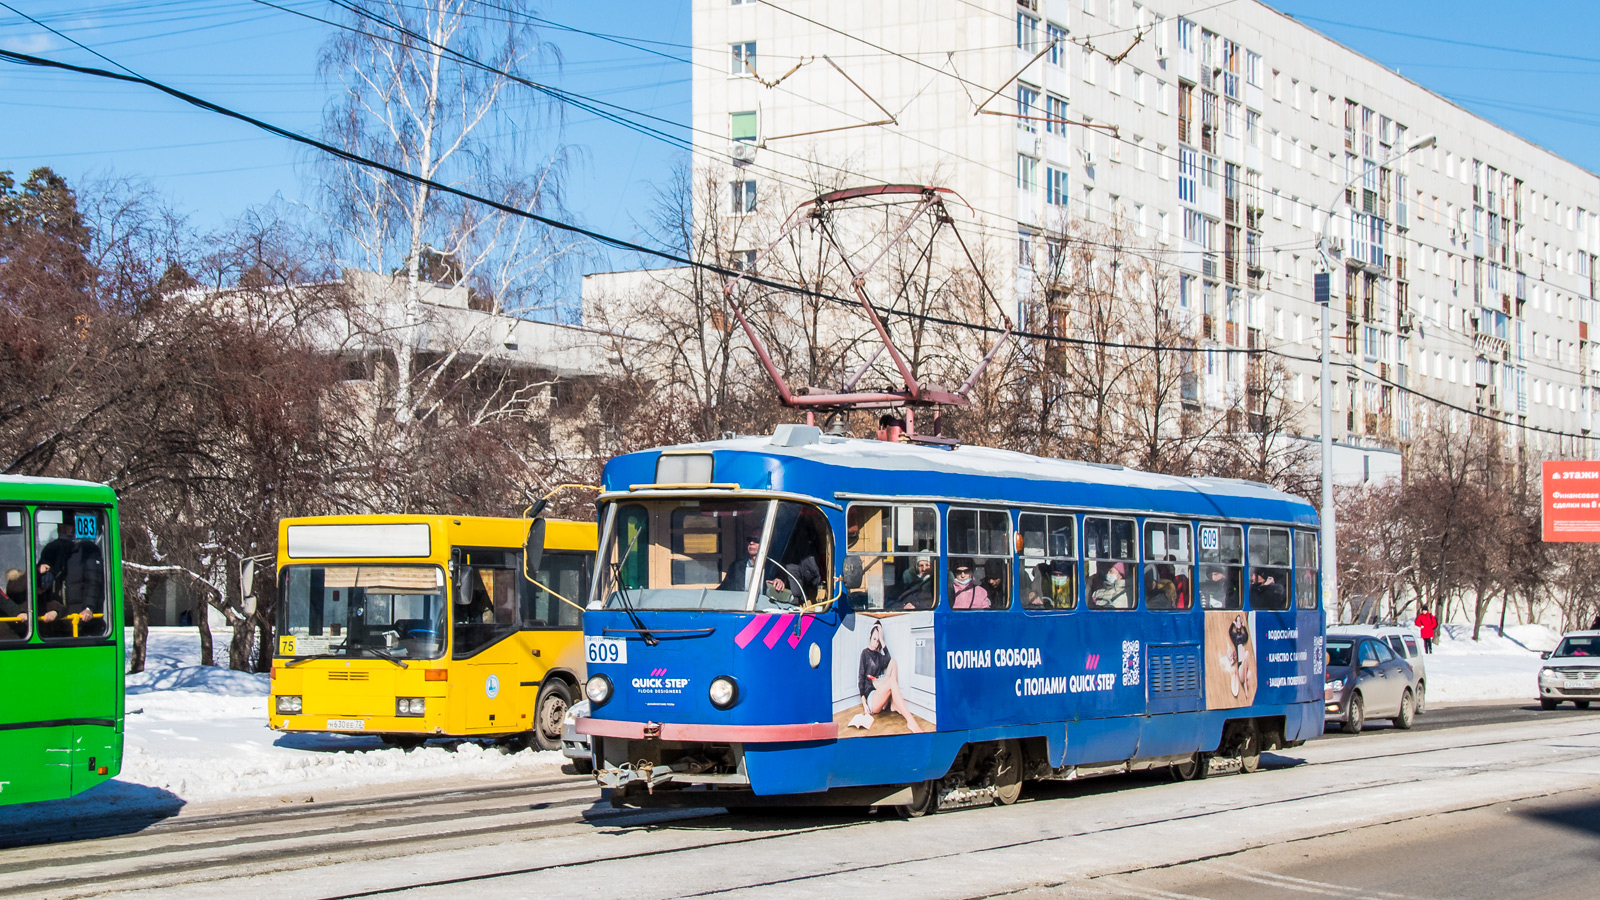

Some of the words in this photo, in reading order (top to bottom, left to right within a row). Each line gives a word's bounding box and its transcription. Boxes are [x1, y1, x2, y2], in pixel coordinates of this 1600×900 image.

[77, 518, 95, 536] 083
[1203, 529, 1217, 547] 609
[282, 641, 294, 652] 75
[589, 643, 619, 662] 609
[947, 650, 991, 669] ПОЛНАЯ
[994, 648, 1042, 668] СВОБОДА
[1015, 679, 1021, 696] С
[1024, 676, 1067, 696] ПОЛАМИ
